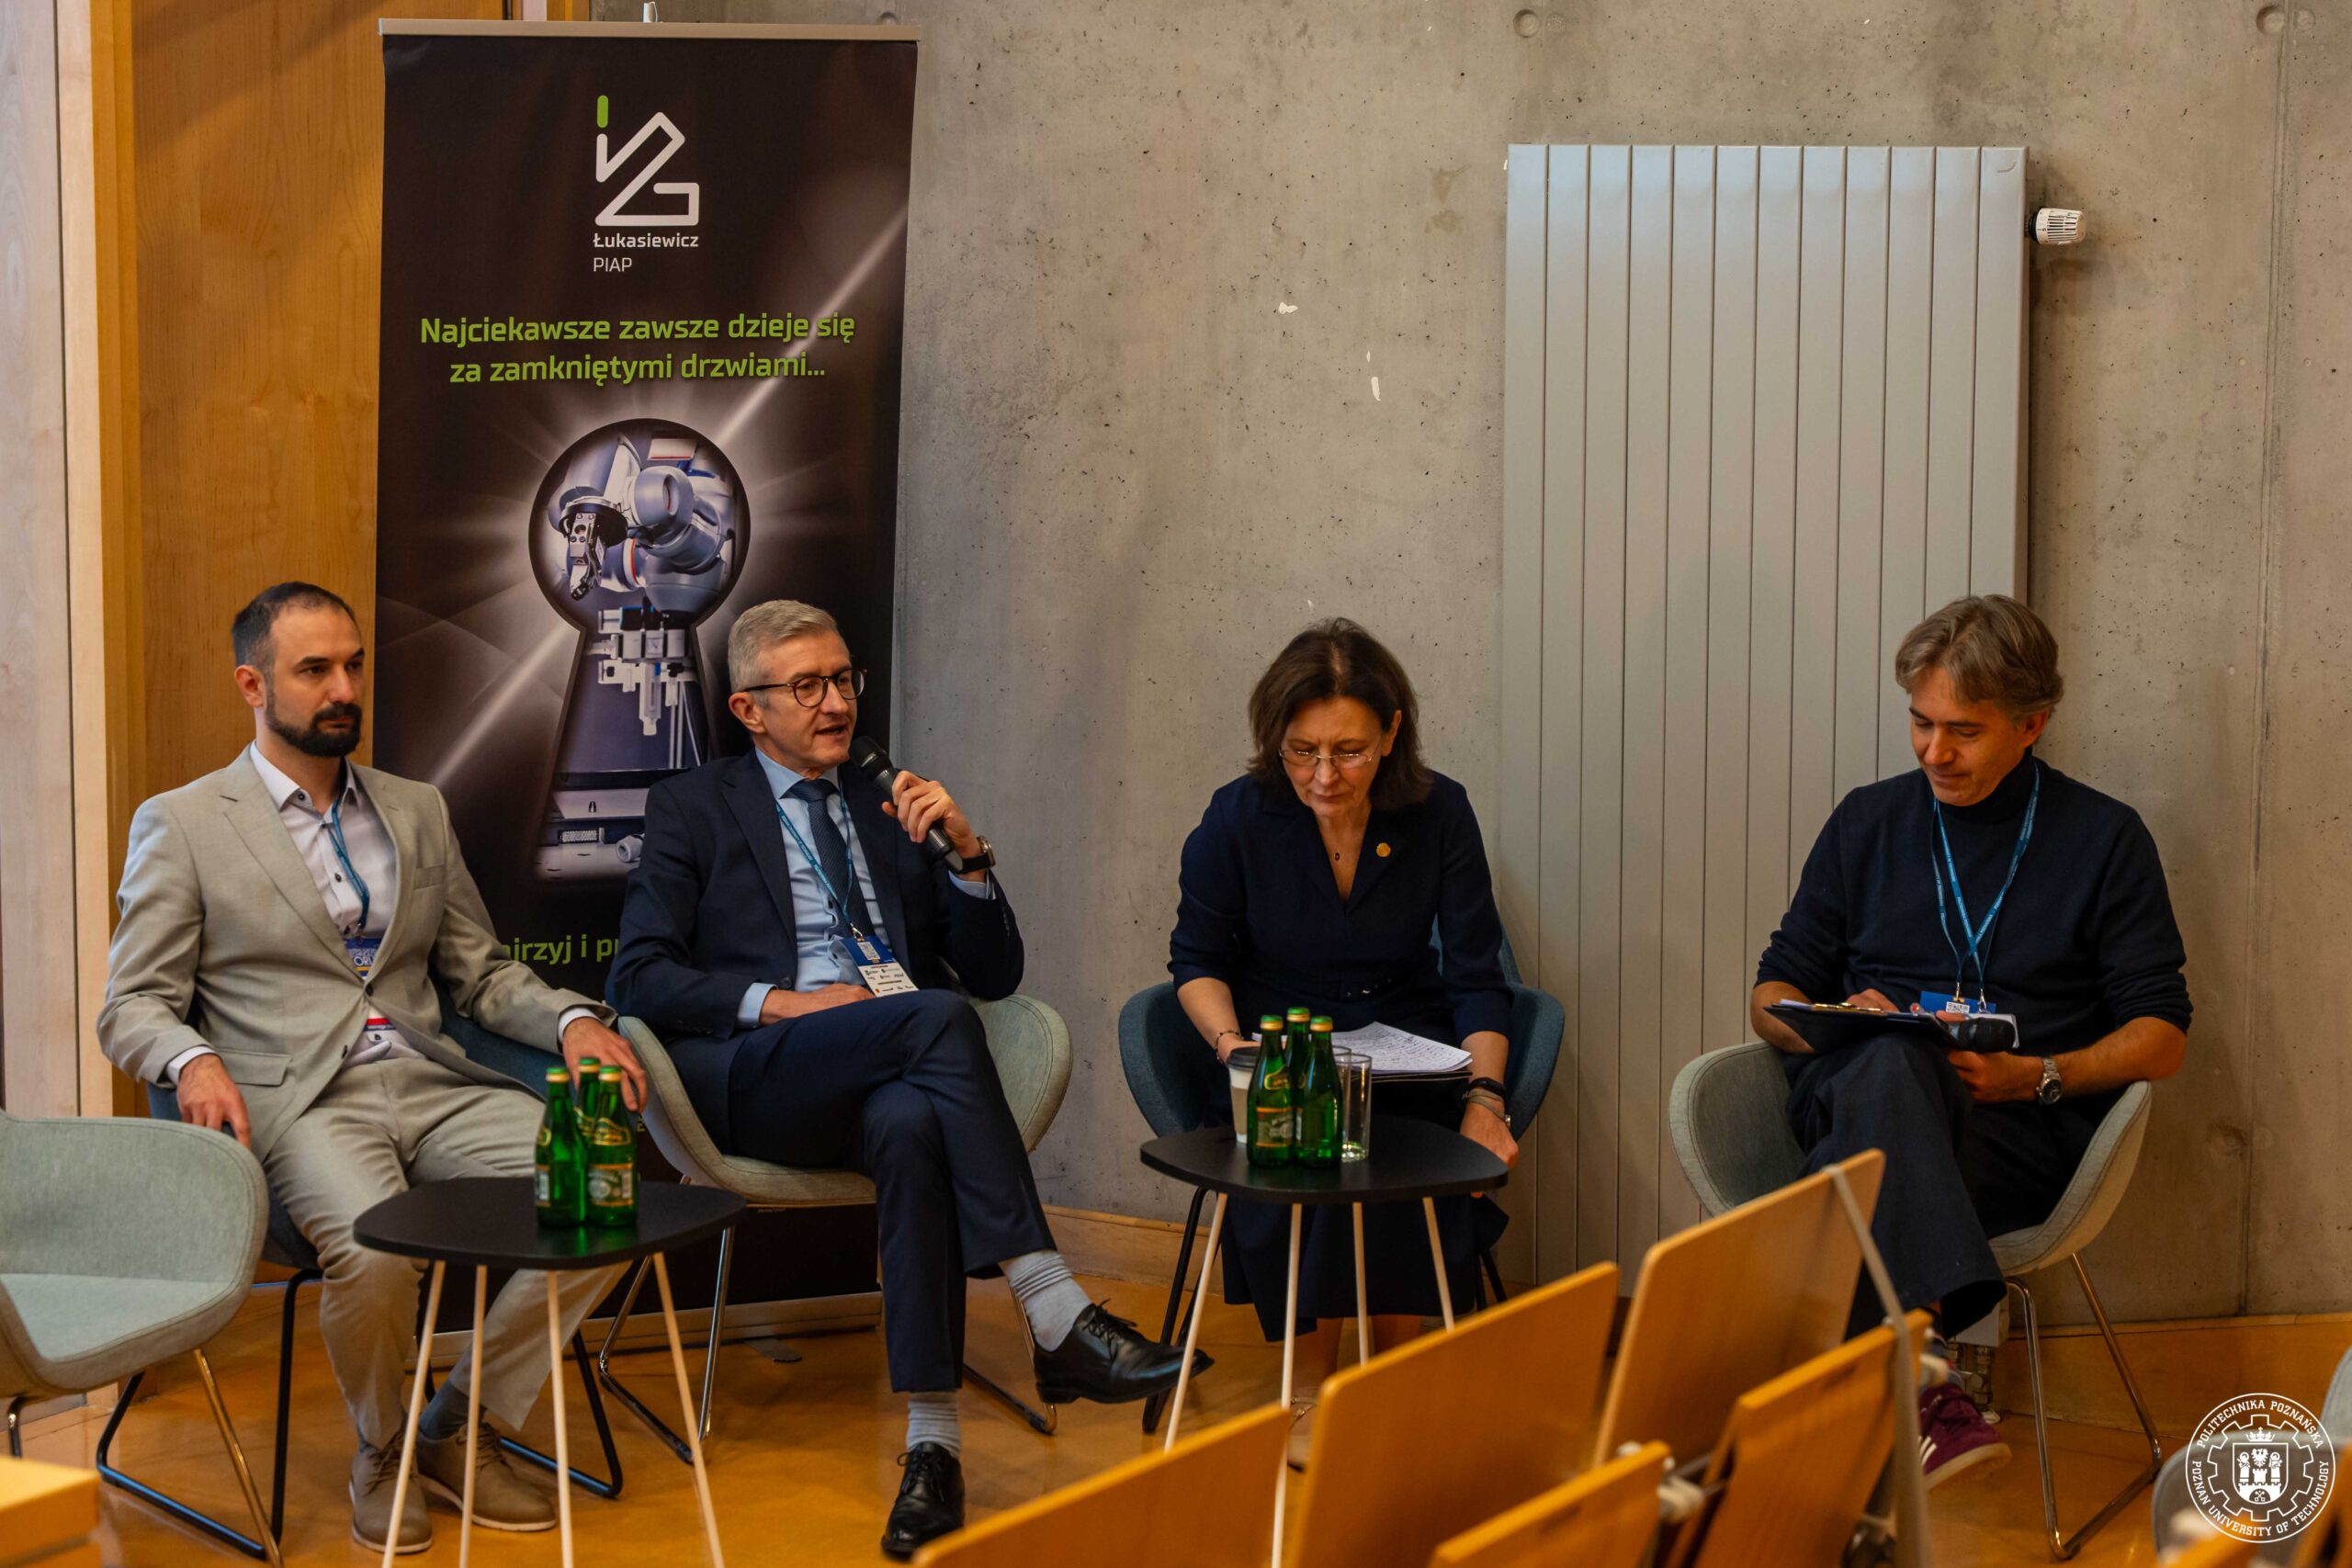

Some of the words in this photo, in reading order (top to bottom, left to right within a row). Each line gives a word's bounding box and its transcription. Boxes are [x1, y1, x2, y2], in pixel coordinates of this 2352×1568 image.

[593, 232, 698, 248] Łukasiewicz
[593, 257, 632, 272] PIAP
[421, 316, 611, 348] Najciekawsze
[618, 319, 719, 340] zawsze
[728, 312, 809, 343] dzieje
[817, 311, 855, 344] się
[449, 363, 481, 383] za
[490, 353, 673, 387] zamkniętymi
[681, 352, 825, 378] drzwiami...
[581, 933, 587, 958] i
